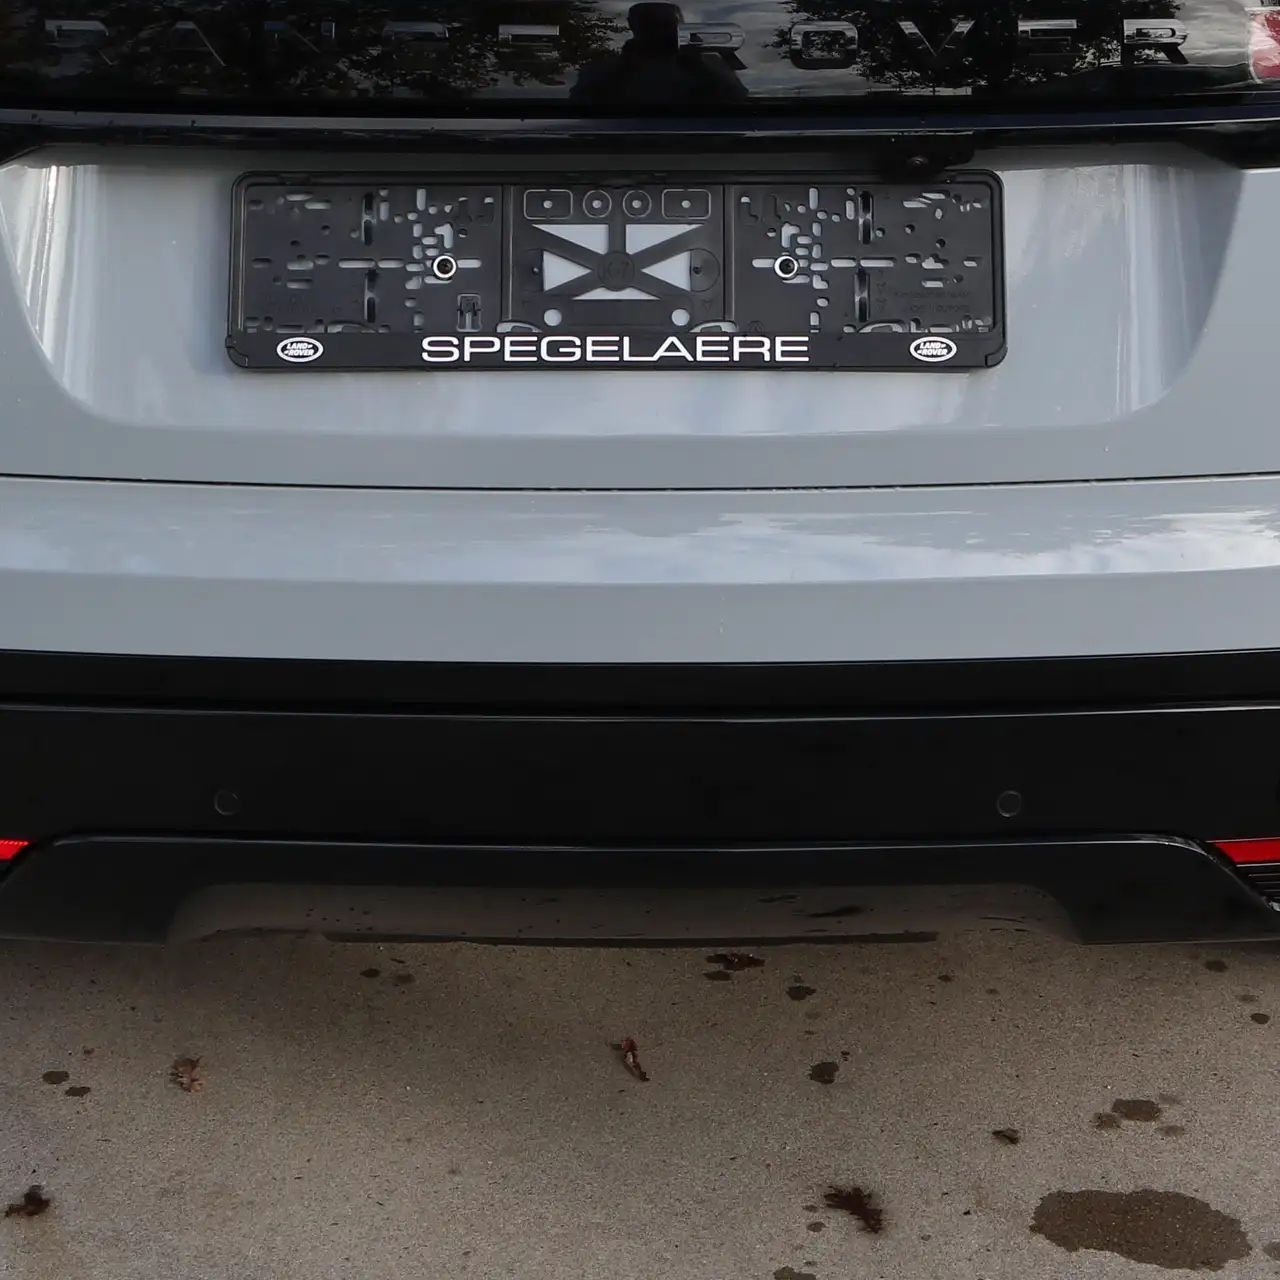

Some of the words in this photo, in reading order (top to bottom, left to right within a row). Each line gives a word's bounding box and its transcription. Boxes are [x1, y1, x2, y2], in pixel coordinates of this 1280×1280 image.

[676, 18, 1189, 71] ROVER
[420, 335, 810, 363] SPEGELAERE
[921, 348, 948, 356] ROVER
